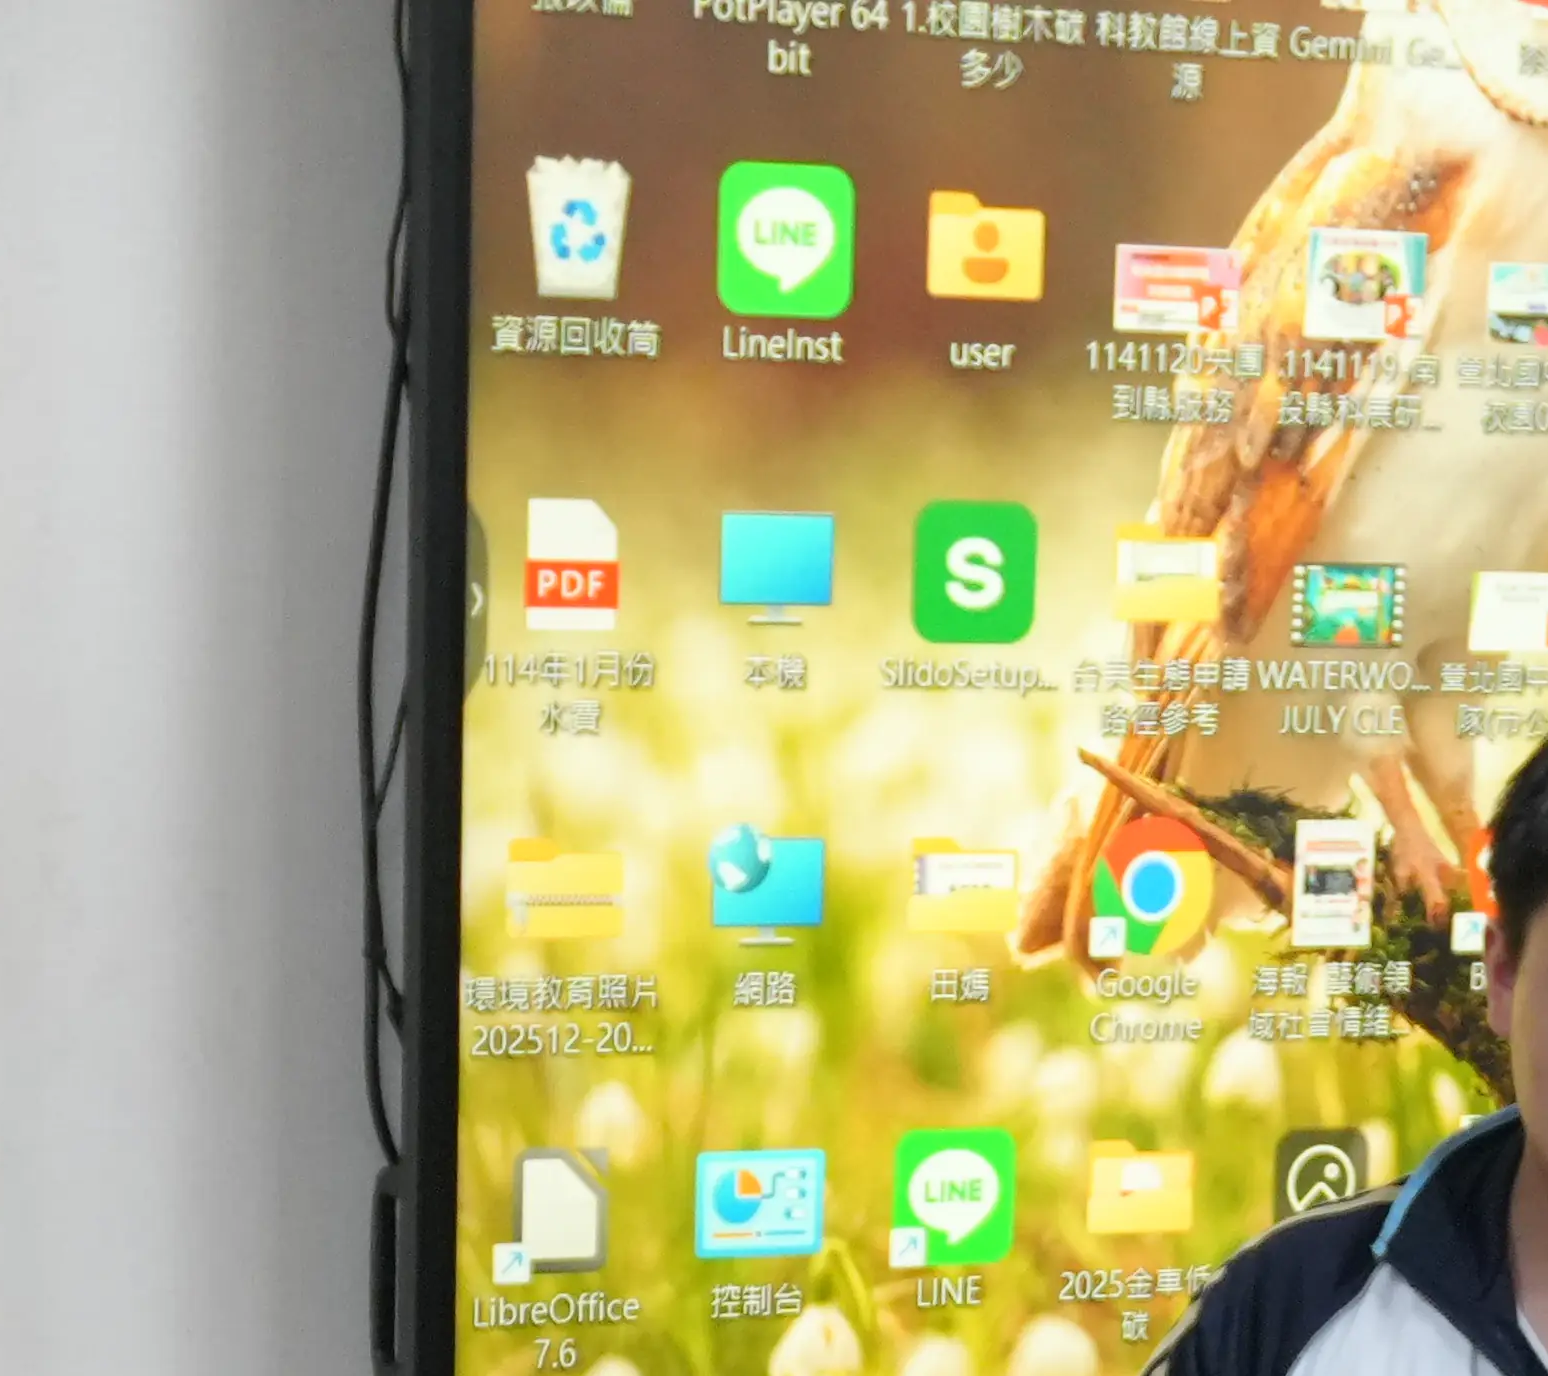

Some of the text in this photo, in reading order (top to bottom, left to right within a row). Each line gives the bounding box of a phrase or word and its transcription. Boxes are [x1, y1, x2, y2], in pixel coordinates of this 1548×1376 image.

[849, 1, 890, 31] 64
[767, 39, 813, 76] bit
[960, 48, 1025, 90] 多少
[1170, 62, 1203, 101] 源
[753, 220, 818, 247] LINE
[491, 315, 661, 357] 資源回收筒
[722, 326, 843, 363] LineInst
[950, 340, 1016, 369] user
[537, 569, 606, 600] PDF
[484, 653, 655, 689] 114年1月份
[744, 656, 807, 690] 本機
[539, 700, 601, 736] 水費
[1278, 704, 1404, 735] JULY CLE
[464, 975, 658, 1011] 環境教育照片
[733, 972, 797, 1008] 網路
[1096, 968, 1198, 1004] Google
[1089, 1012, 1202, 1044] Chrome
[923, 1178, 985, 1204] LINE
[710, 1283, 802, 1320] 控制台
[916, 1275, 982, 1307] LINE
[473, 1291, 641, 1328] LibreOffice
[1121, 1312, 1150, 1342] 碳
[533, 1338, 578, 1369] 7.6
